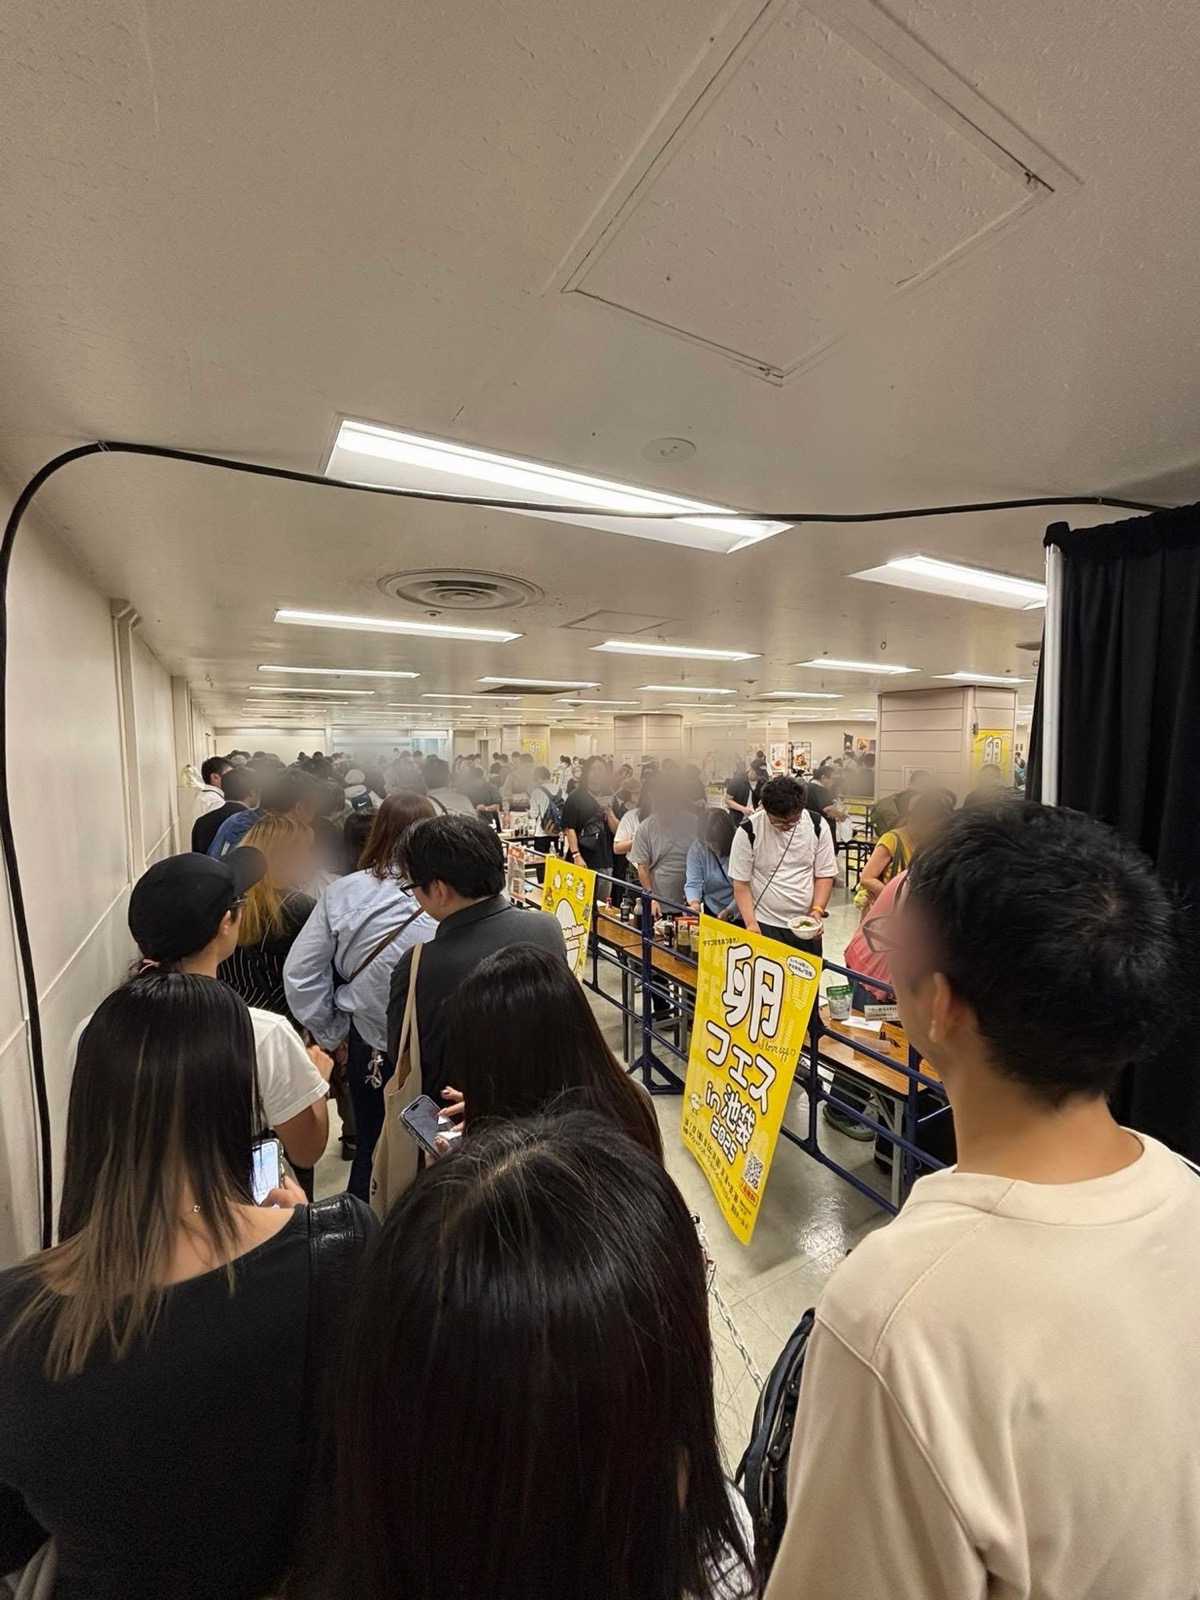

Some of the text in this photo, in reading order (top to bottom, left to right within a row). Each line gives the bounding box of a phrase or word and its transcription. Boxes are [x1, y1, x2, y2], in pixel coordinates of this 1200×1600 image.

[721, 943, 785, 1043] 卵
[706, 1019, 777, 1115] フェス
[710, 1114, 739, 1166] 2025
